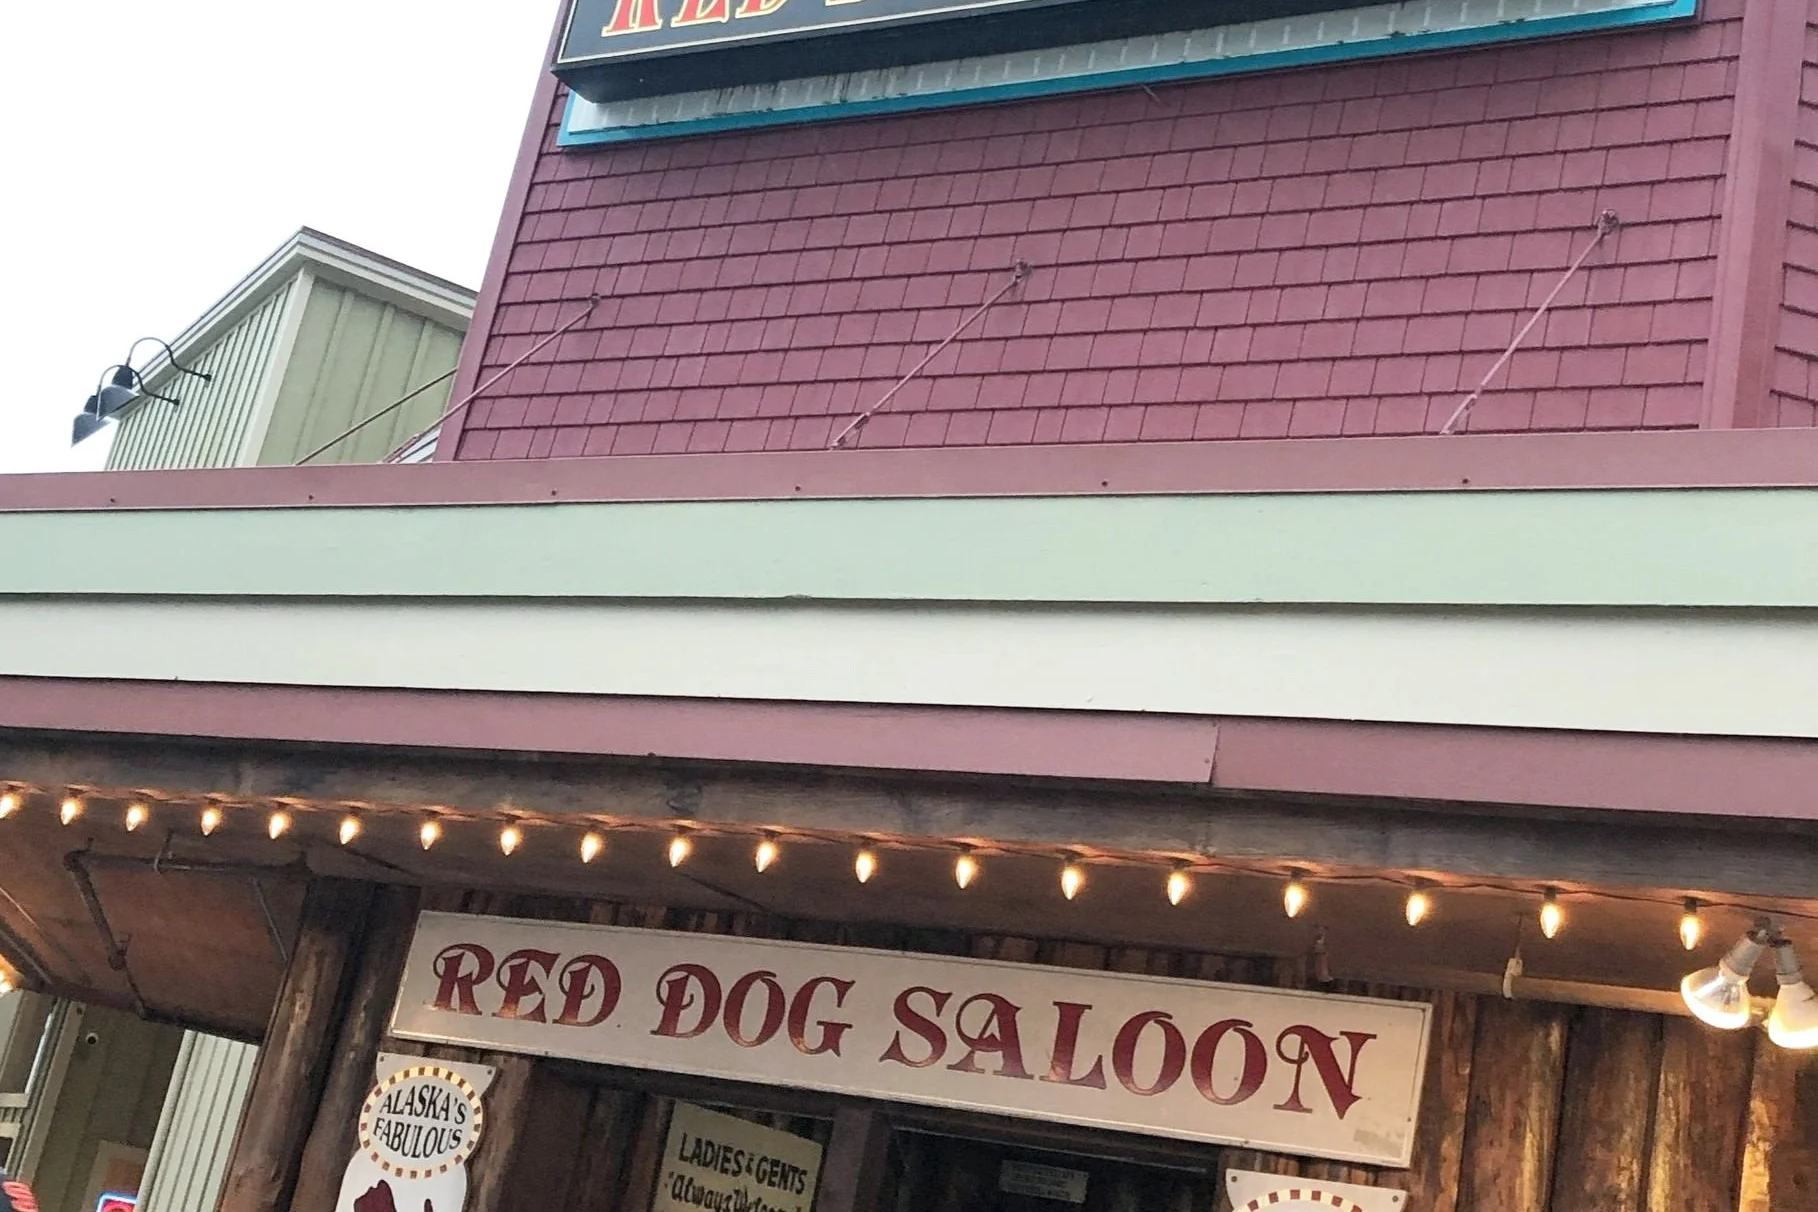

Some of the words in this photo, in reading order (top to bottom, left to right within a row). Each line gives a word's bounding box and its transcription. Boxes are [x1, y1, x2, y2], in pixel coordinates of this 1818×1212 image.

[428, 943, 622, 1027] RED
[651, 963, 856, 1057] DOG
[879, 986, 1378, 1120] SALOON
[379, 1084, 467, 1125] ALASKA'S
[373, 1117, 463, 1158] FABULOUS
[678, 1132, 745, 1177] LADIES
[755, 1155, 808, 1195] GENTS
